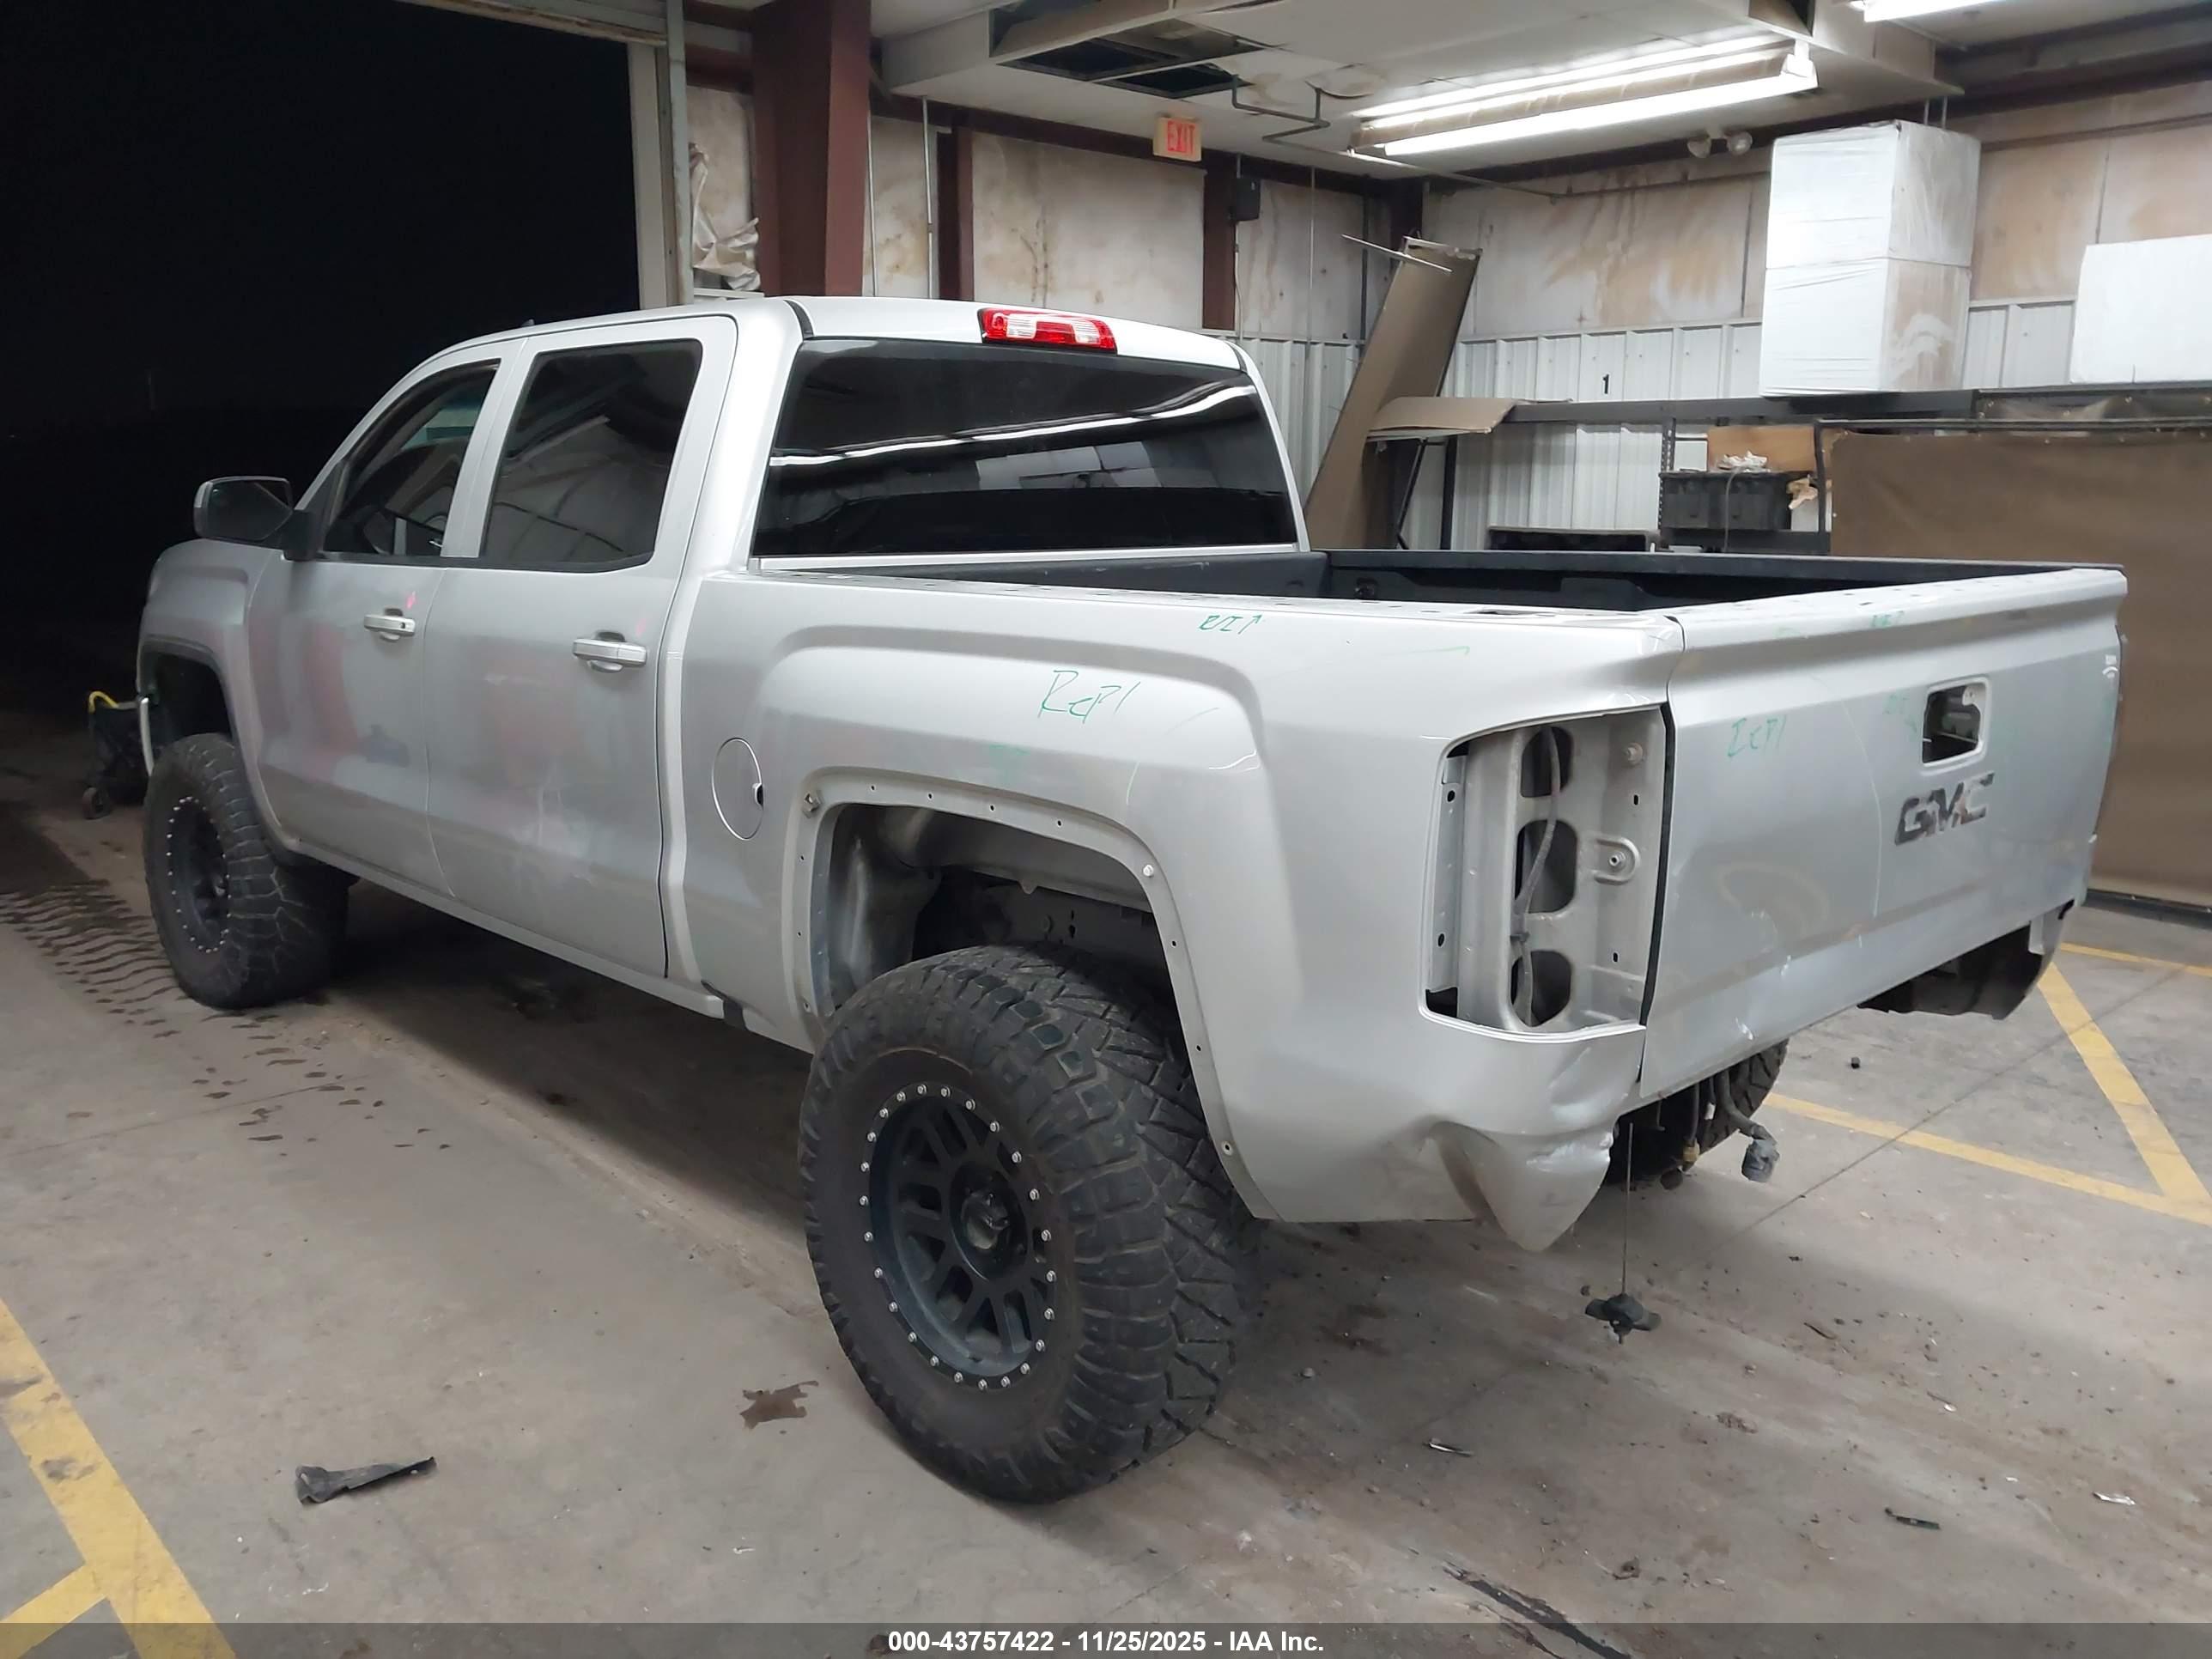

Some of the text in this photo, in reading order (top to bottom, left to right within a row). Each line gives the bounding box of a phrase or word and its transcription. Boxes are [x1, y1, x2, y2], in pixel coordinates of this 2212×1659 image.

[1168, 120, 1196, 155] EXIT
[1602, 374, 1610, 394] 1
[1894, 769, 1996, 847] GMC
